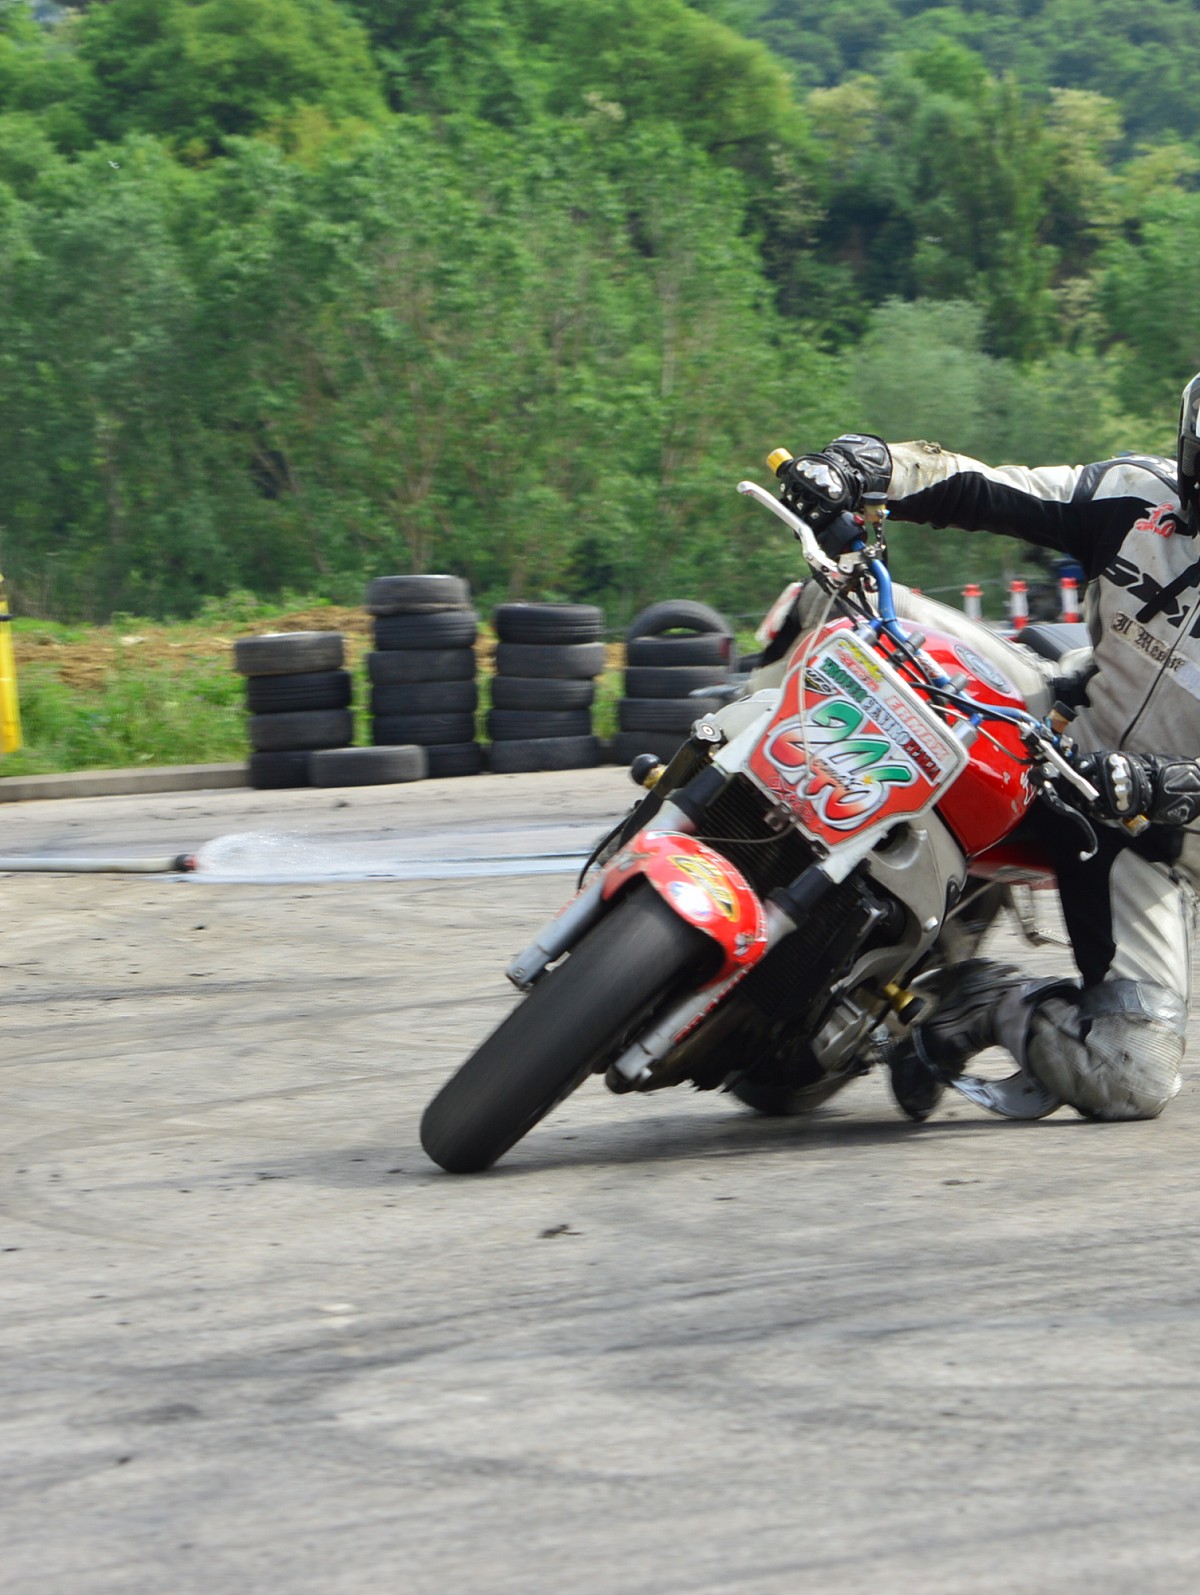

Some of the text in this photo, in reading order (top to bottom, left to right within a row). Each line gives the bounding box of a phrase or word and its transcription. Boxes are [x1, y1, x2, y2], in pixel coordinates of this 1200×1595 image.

[806, 669, 832, 693] UFO
[768, 699, 913, 822] 246
[884, 695, 951, 761] ERMAX
